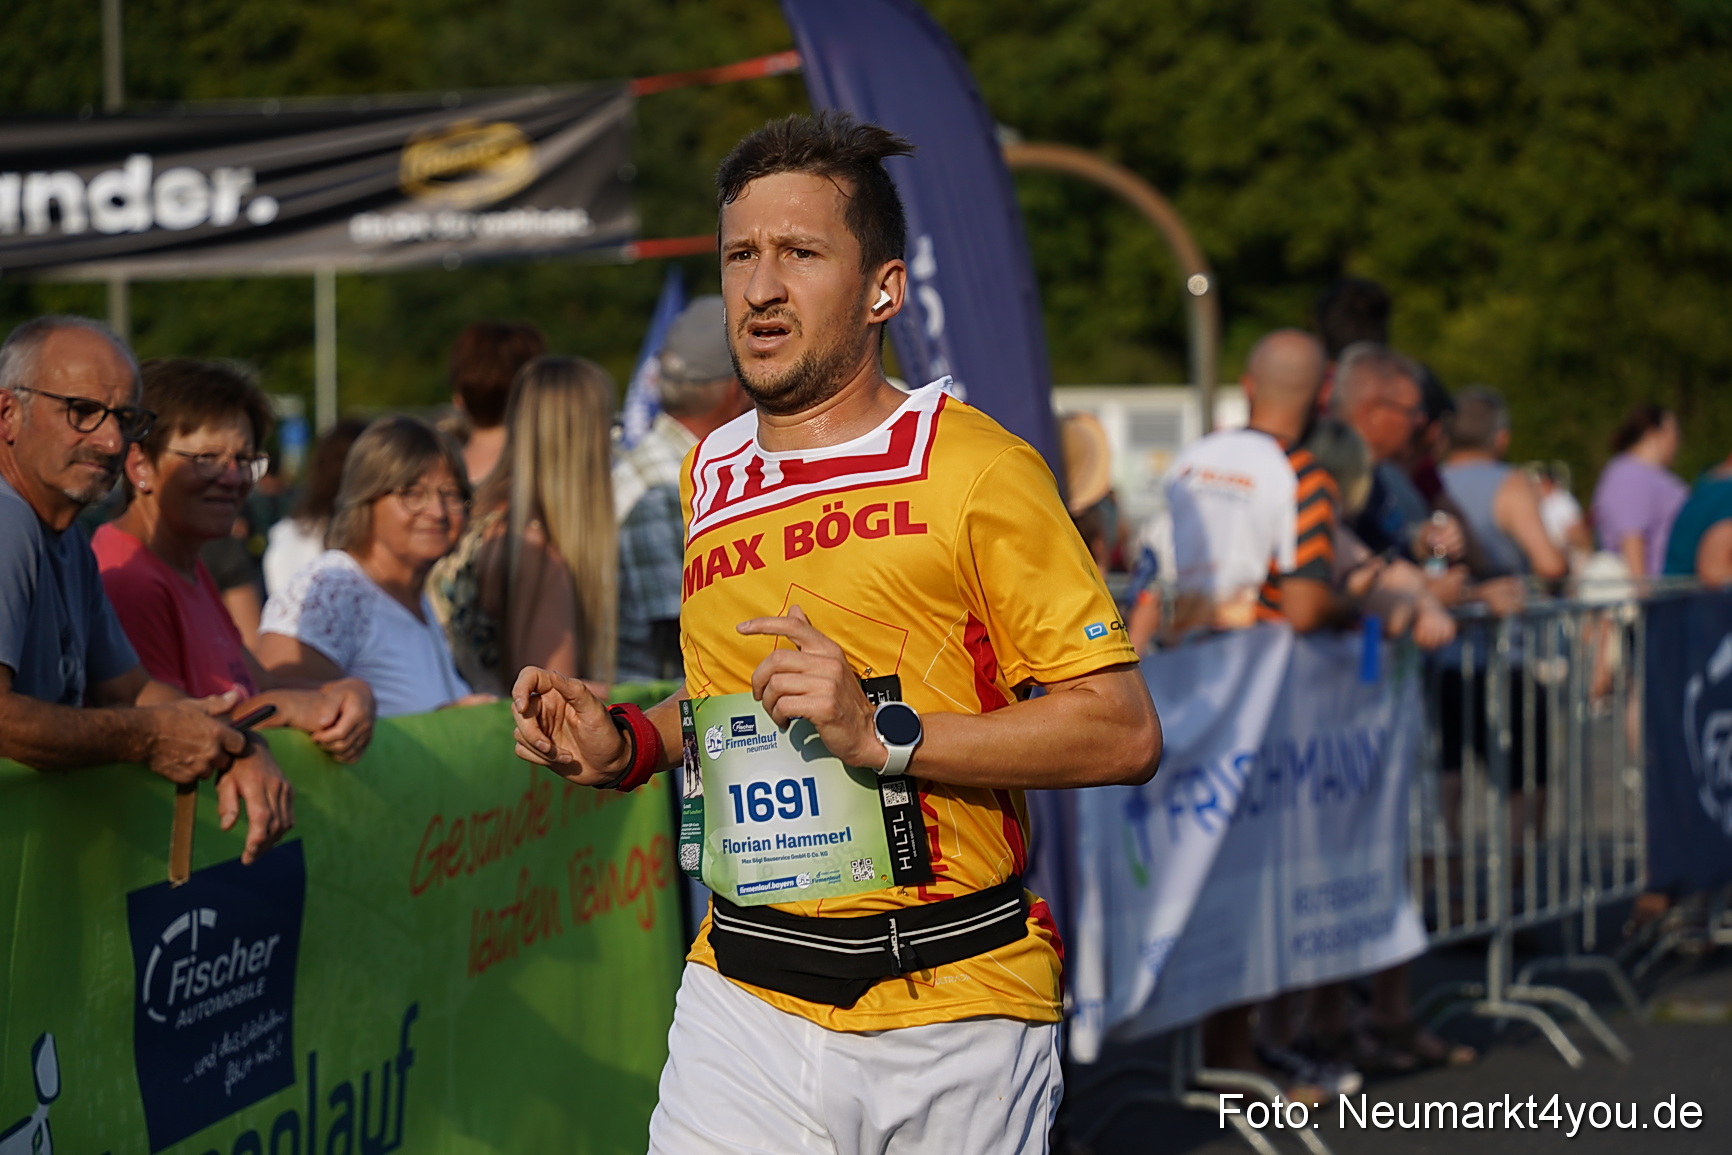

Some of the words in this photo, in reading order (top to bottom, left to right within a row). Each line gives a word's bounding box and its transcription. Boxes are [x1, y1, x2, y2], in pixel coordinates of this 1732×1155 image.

[683, 532, 767, 605] MAX
[783, 500, 928, 562] BÖGL
[725, 731, 778, 750] Firmenlauf
[746, 742, 778, 754] neumarkt
[728, 776, 820, 824] 1691
[722, 836, 771, 855] Florian
[775, 826, 852, 850] Hammerl
[741, 857, 752, 865] Max
[752, 856, 763, 864] Bögl
[763, 854, 791, 863] Bauservice
[791, 852, 806, 860] GmbH
[892, 810, 912, 871] HILTL
[567, 831, 679, 933] länge
[739, 878, 795, 895] firmenlauf.bayern
[167, 934, 281, 1006] Fischer
[174, 976, 266, 1031] AUTOMOBILE
